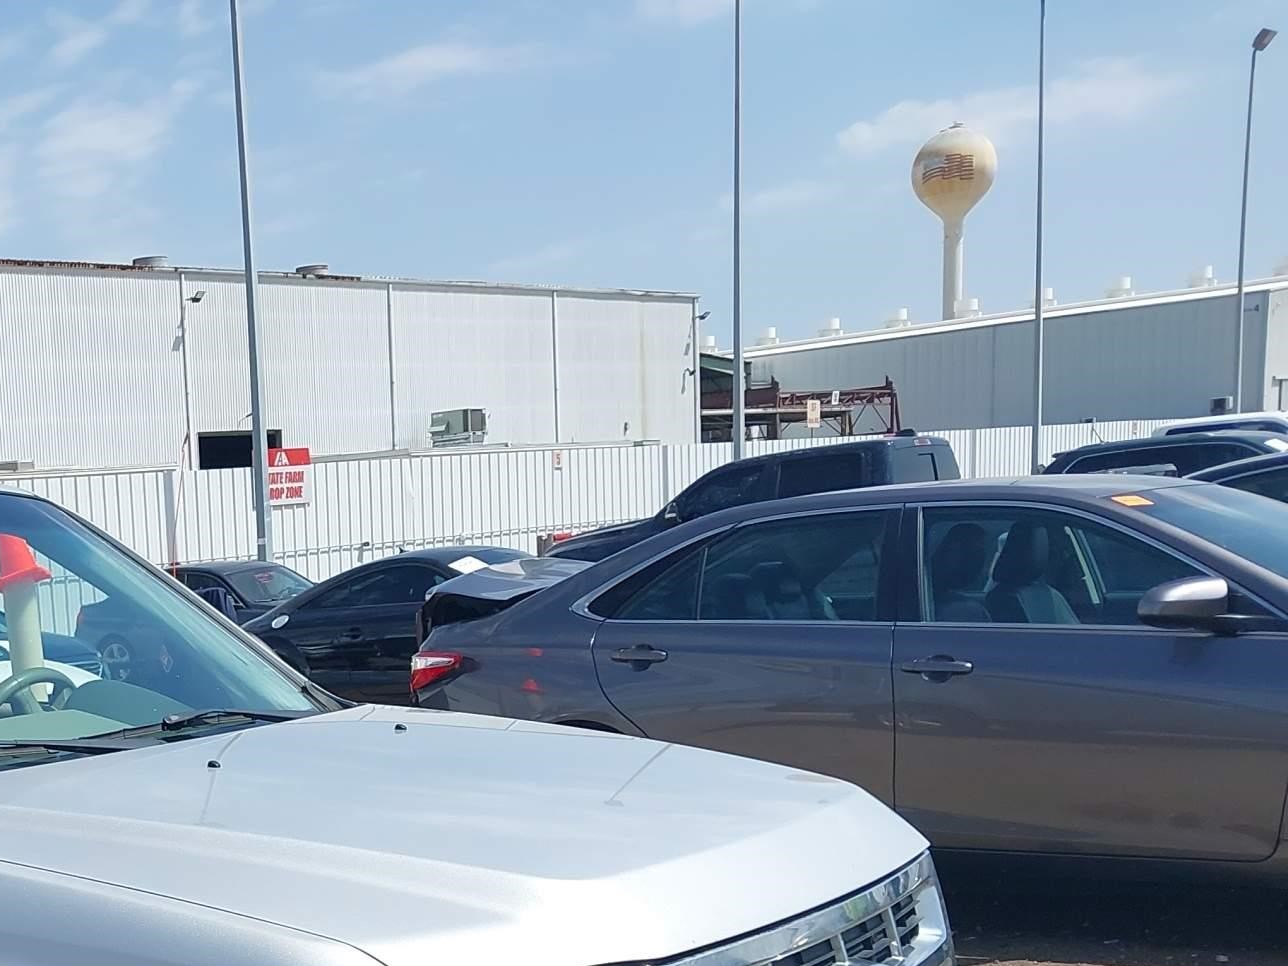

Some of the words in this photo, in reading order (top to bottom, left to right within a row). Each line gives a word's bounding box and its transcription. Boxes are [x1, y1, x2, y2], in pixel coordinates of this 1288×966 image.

[268, 472, 284, 485] TATE
[285, 471, 304, 484] FARM
[269, 486, 285, 500] ROP
[286, 486, 303, 499] ZONE
